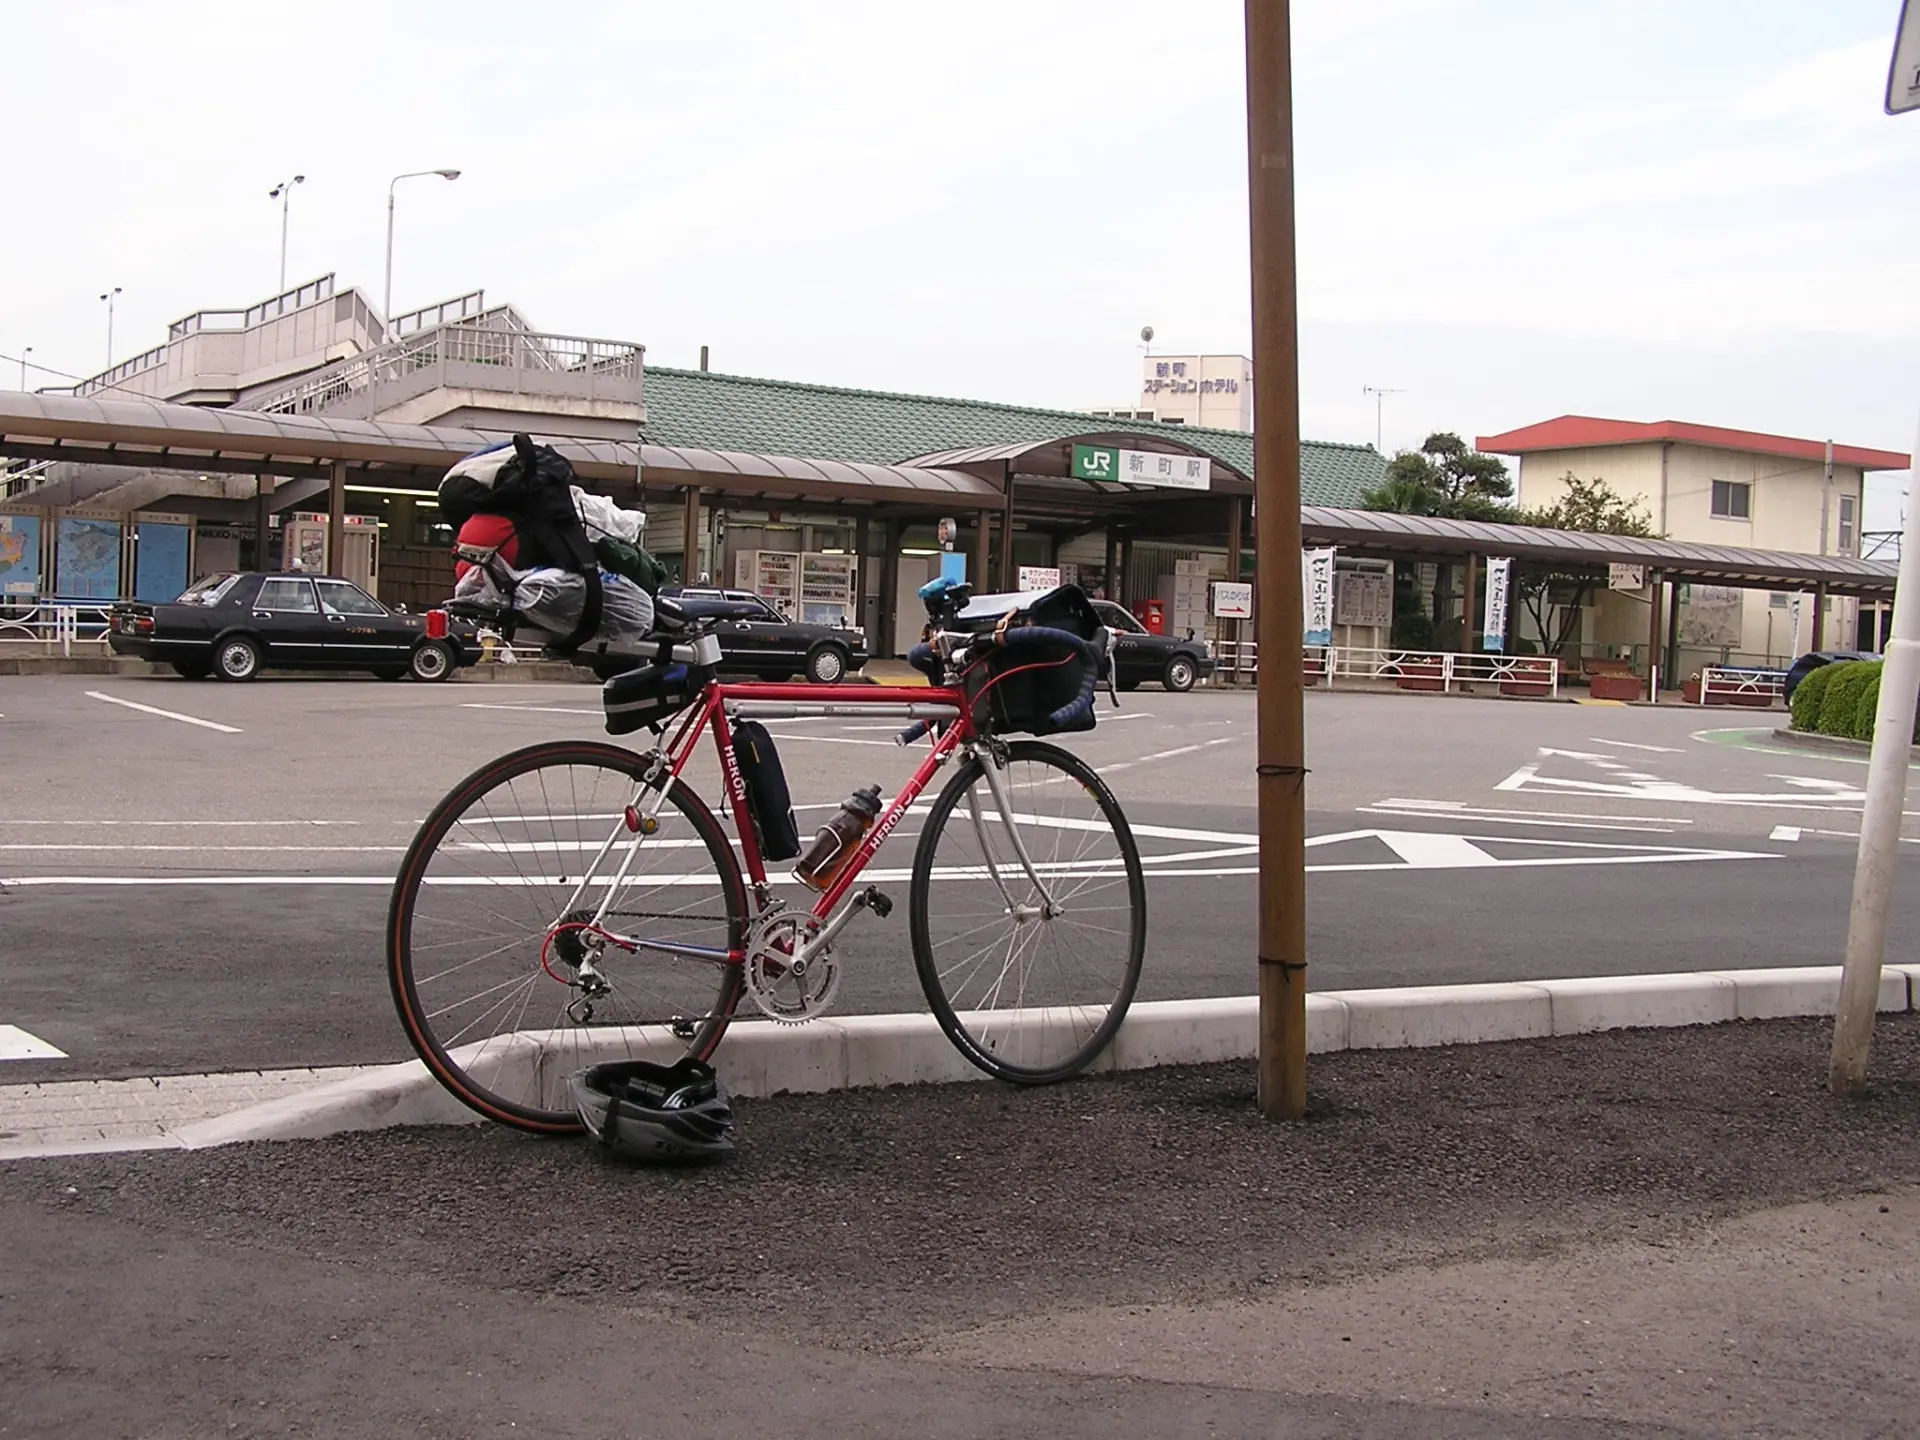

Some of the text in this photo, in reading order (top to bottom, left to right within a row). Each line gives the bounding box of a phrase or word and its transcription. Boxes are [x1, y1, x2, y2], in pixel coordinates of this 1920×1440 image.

[1156, 362, 1186, 378] 新町
[1083, 451, 1111, 471] JR
[1129, 454, 1201, 478] 新町駅
[1215, 589, 1250, 602] バスのりば
[724, 745, 747, 801] HERON
[869, 804, 905, 850] HERON
